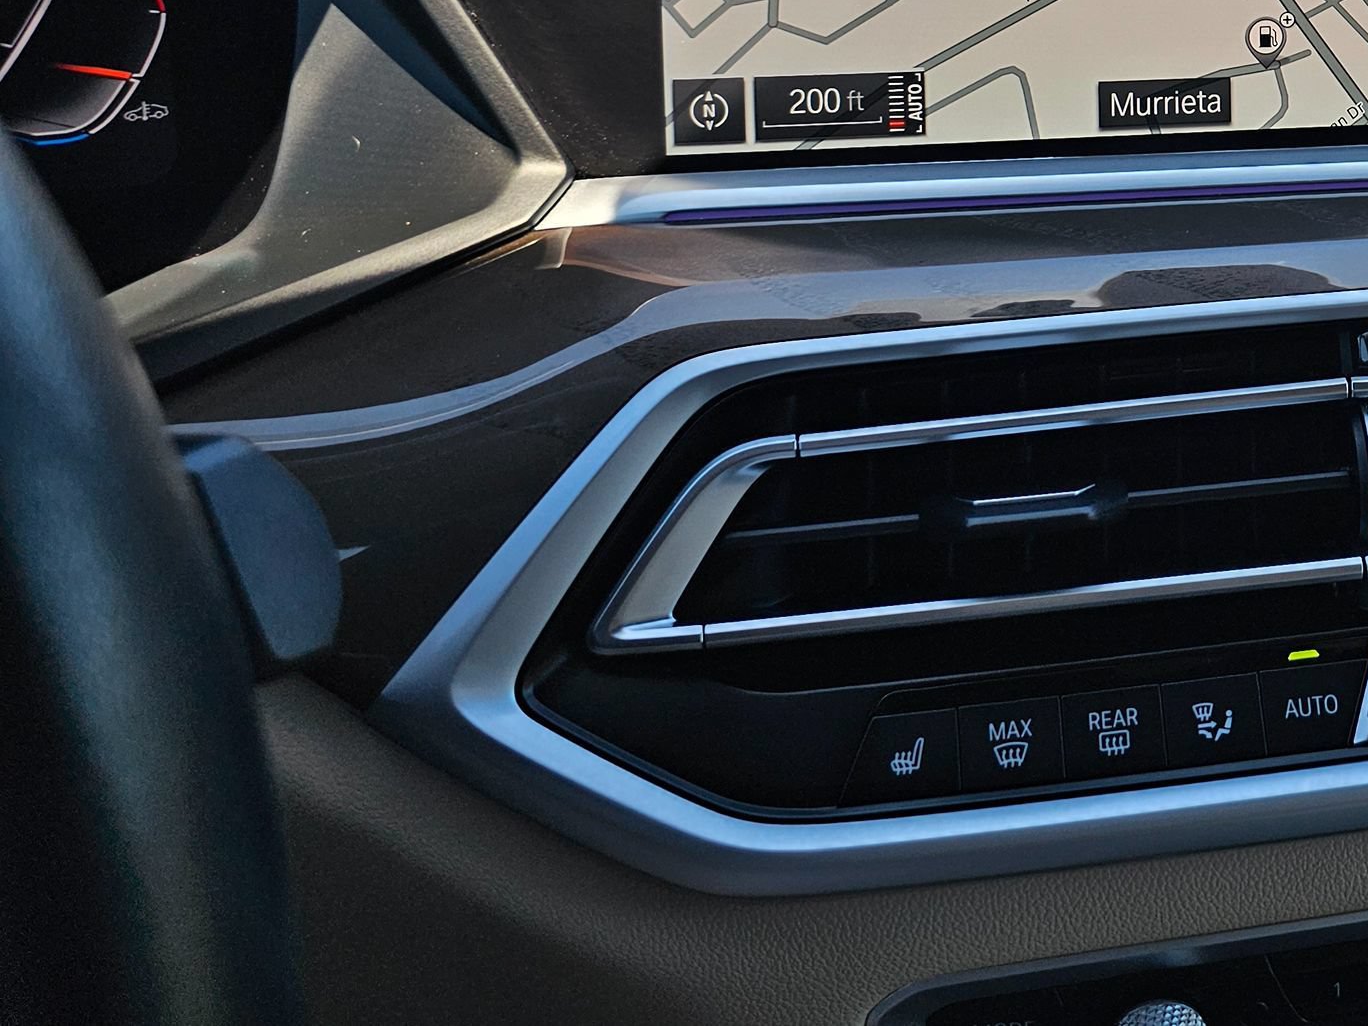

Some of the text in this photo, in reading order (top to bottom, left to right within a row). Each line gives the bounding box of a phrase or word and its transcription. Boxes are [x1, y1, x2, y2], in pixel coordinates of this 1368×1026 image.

[704, 103, 716, 118] N
[789, 88, 864, 114] 200 ft
[908, 84, 923, 121] AUTO
[1110, 90, 1222, 117] Murrieta
[1347, 102, 1364, 119] Dr
[1286, 694, 1339, 719] AUTO
[989, 718, 1033, 741] MAX
[1089, 707, 1138, 731] REAR
[1333, 981, 1341, 998] 1
